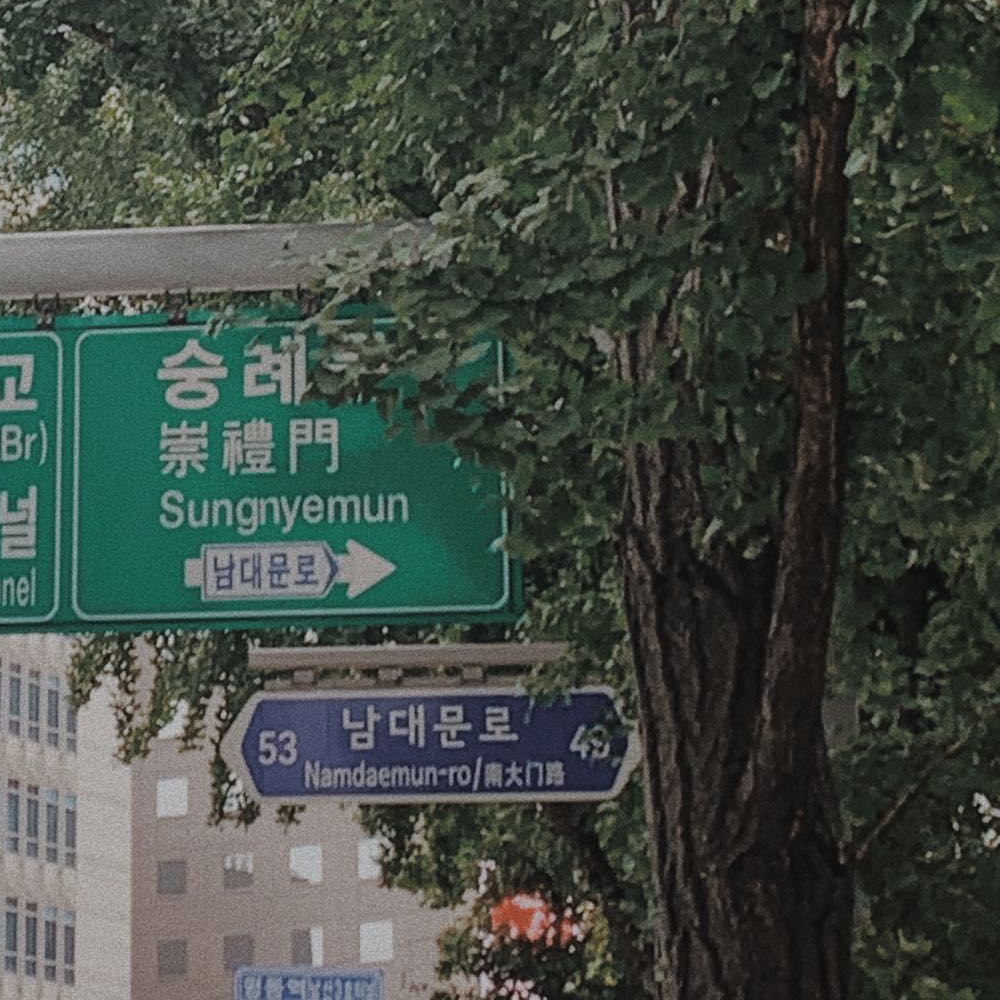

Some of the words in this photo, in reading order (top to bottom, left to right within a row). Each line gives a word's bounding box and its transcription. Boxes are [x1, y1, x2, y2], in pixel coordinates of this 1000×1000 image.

[159, 417, 340, 479] 崇禮門
[159, 489, 410, 536] Sungnyemun
[212, 553, 320, 591] 남대문로
[257, 730, 298, 766] 53
[342, 703, 520, 751] 남대문로
